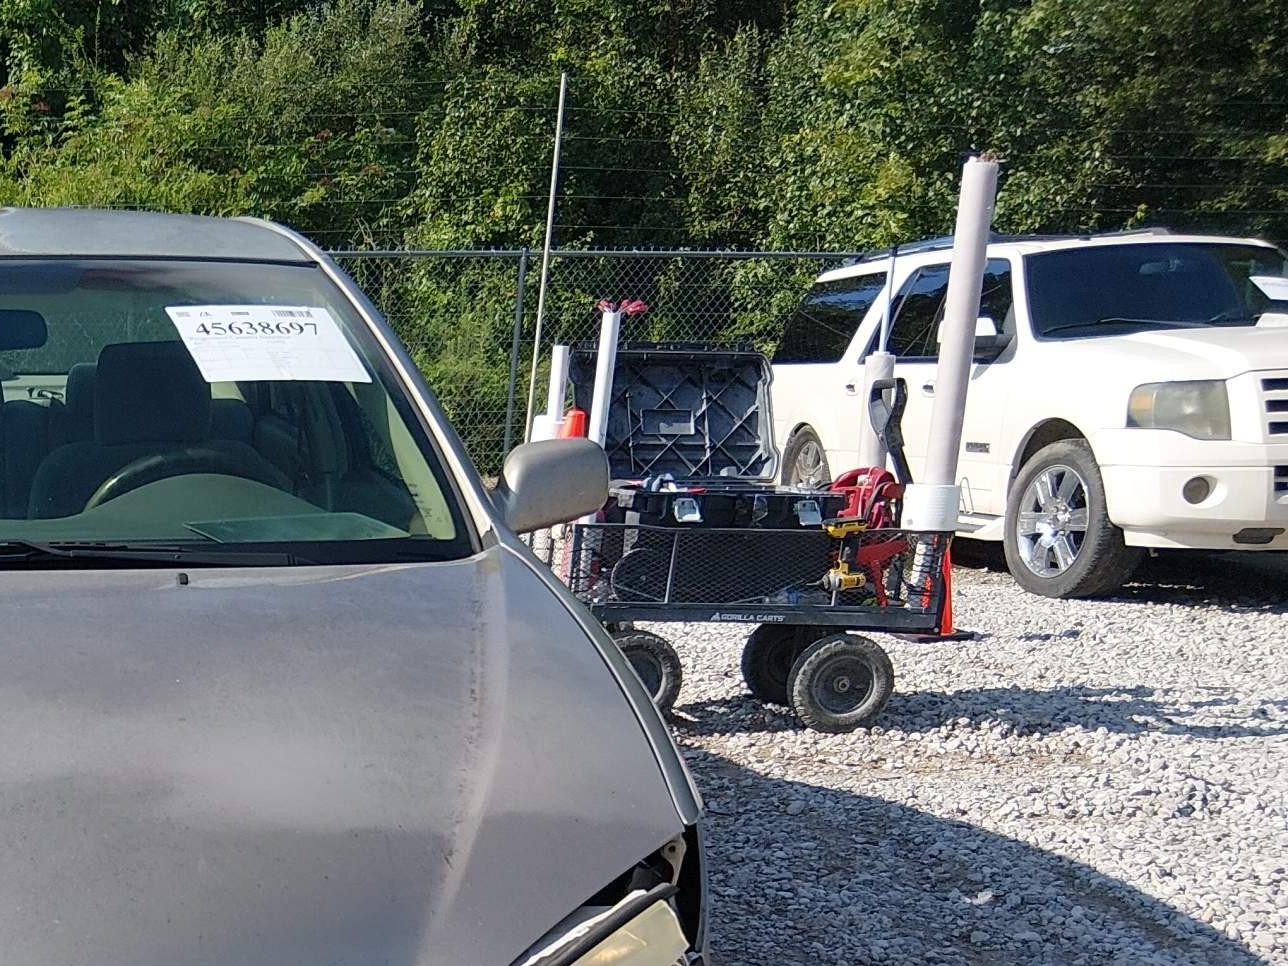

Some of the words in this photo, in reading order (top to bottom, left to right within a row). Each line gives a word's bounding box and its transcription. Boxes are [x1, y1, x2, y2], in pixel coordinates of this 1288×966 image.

[196, 321, 318, 336] 45638697
[721, 613, 754, 621] GORILLA
[756, 614, 785, 622] CARTS
